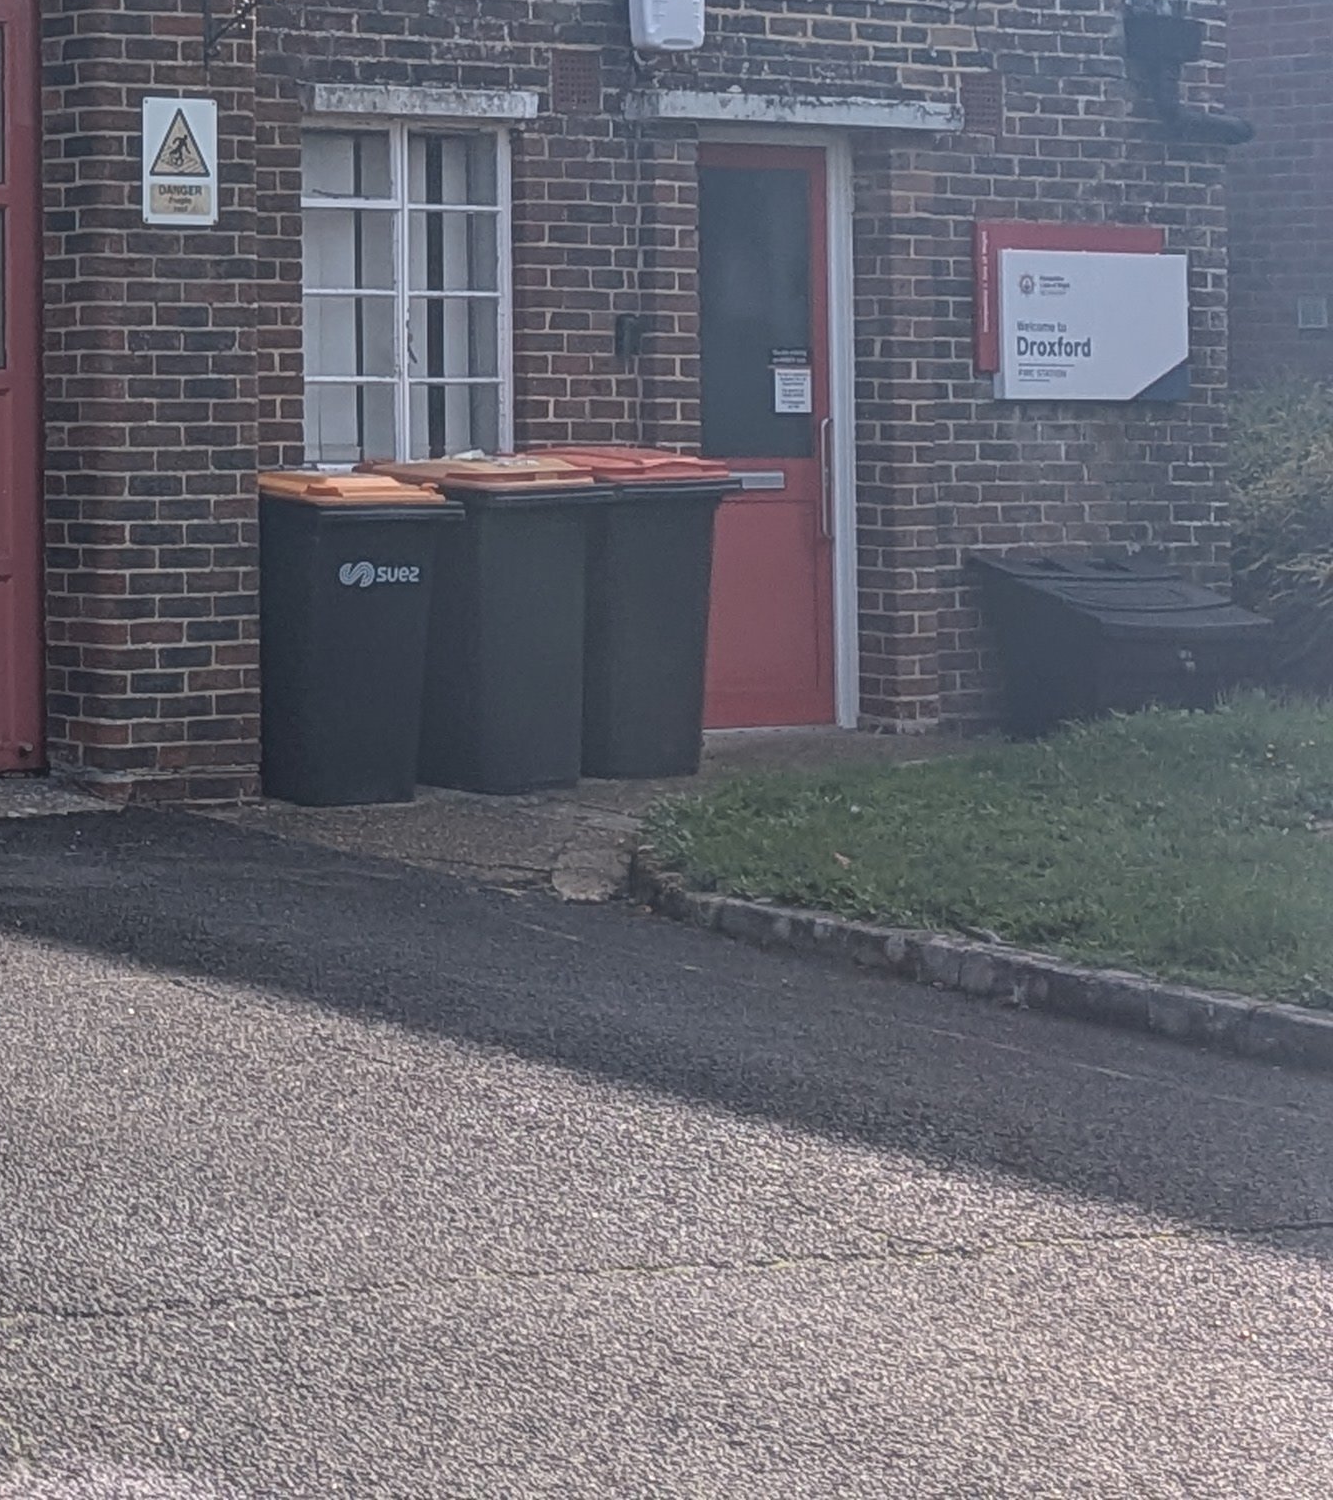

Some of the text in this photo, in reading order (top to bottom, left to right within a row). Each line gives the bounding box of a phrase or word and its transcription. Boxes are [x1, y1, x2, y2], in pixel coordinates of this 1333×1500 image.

[158, 184, 202, 196] DANGER
[1016, 320, 1067, 332] Welcome to
[1017, 336, 1091, 357] Droxford
[375, 566, 420, 582] suez
